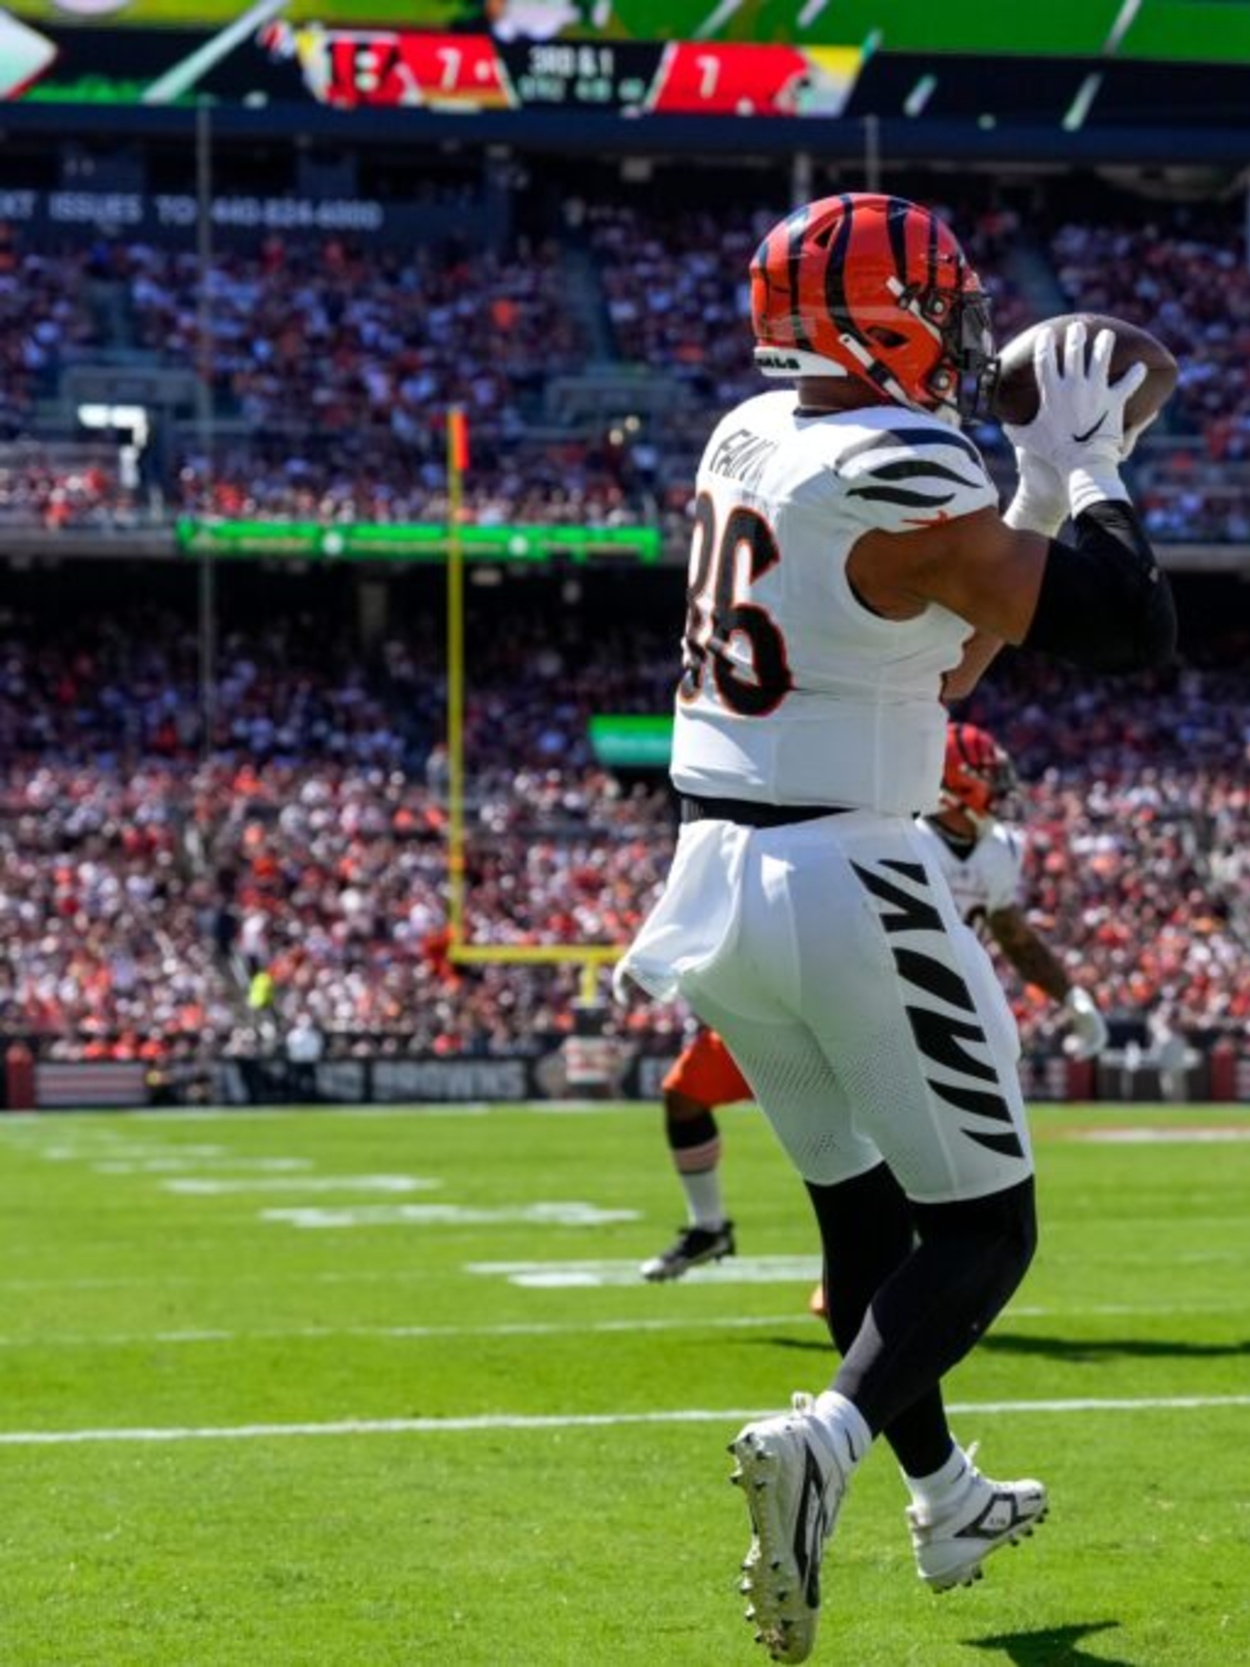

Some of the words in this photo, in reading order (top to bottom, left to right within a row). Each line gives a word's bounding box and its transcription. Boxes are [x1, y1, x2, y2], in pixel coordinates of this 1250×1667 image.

[436, 46, 461, 91] 7
[50, 191, 143, 225] ISSUES
[156, 194, 197, 226] TO
